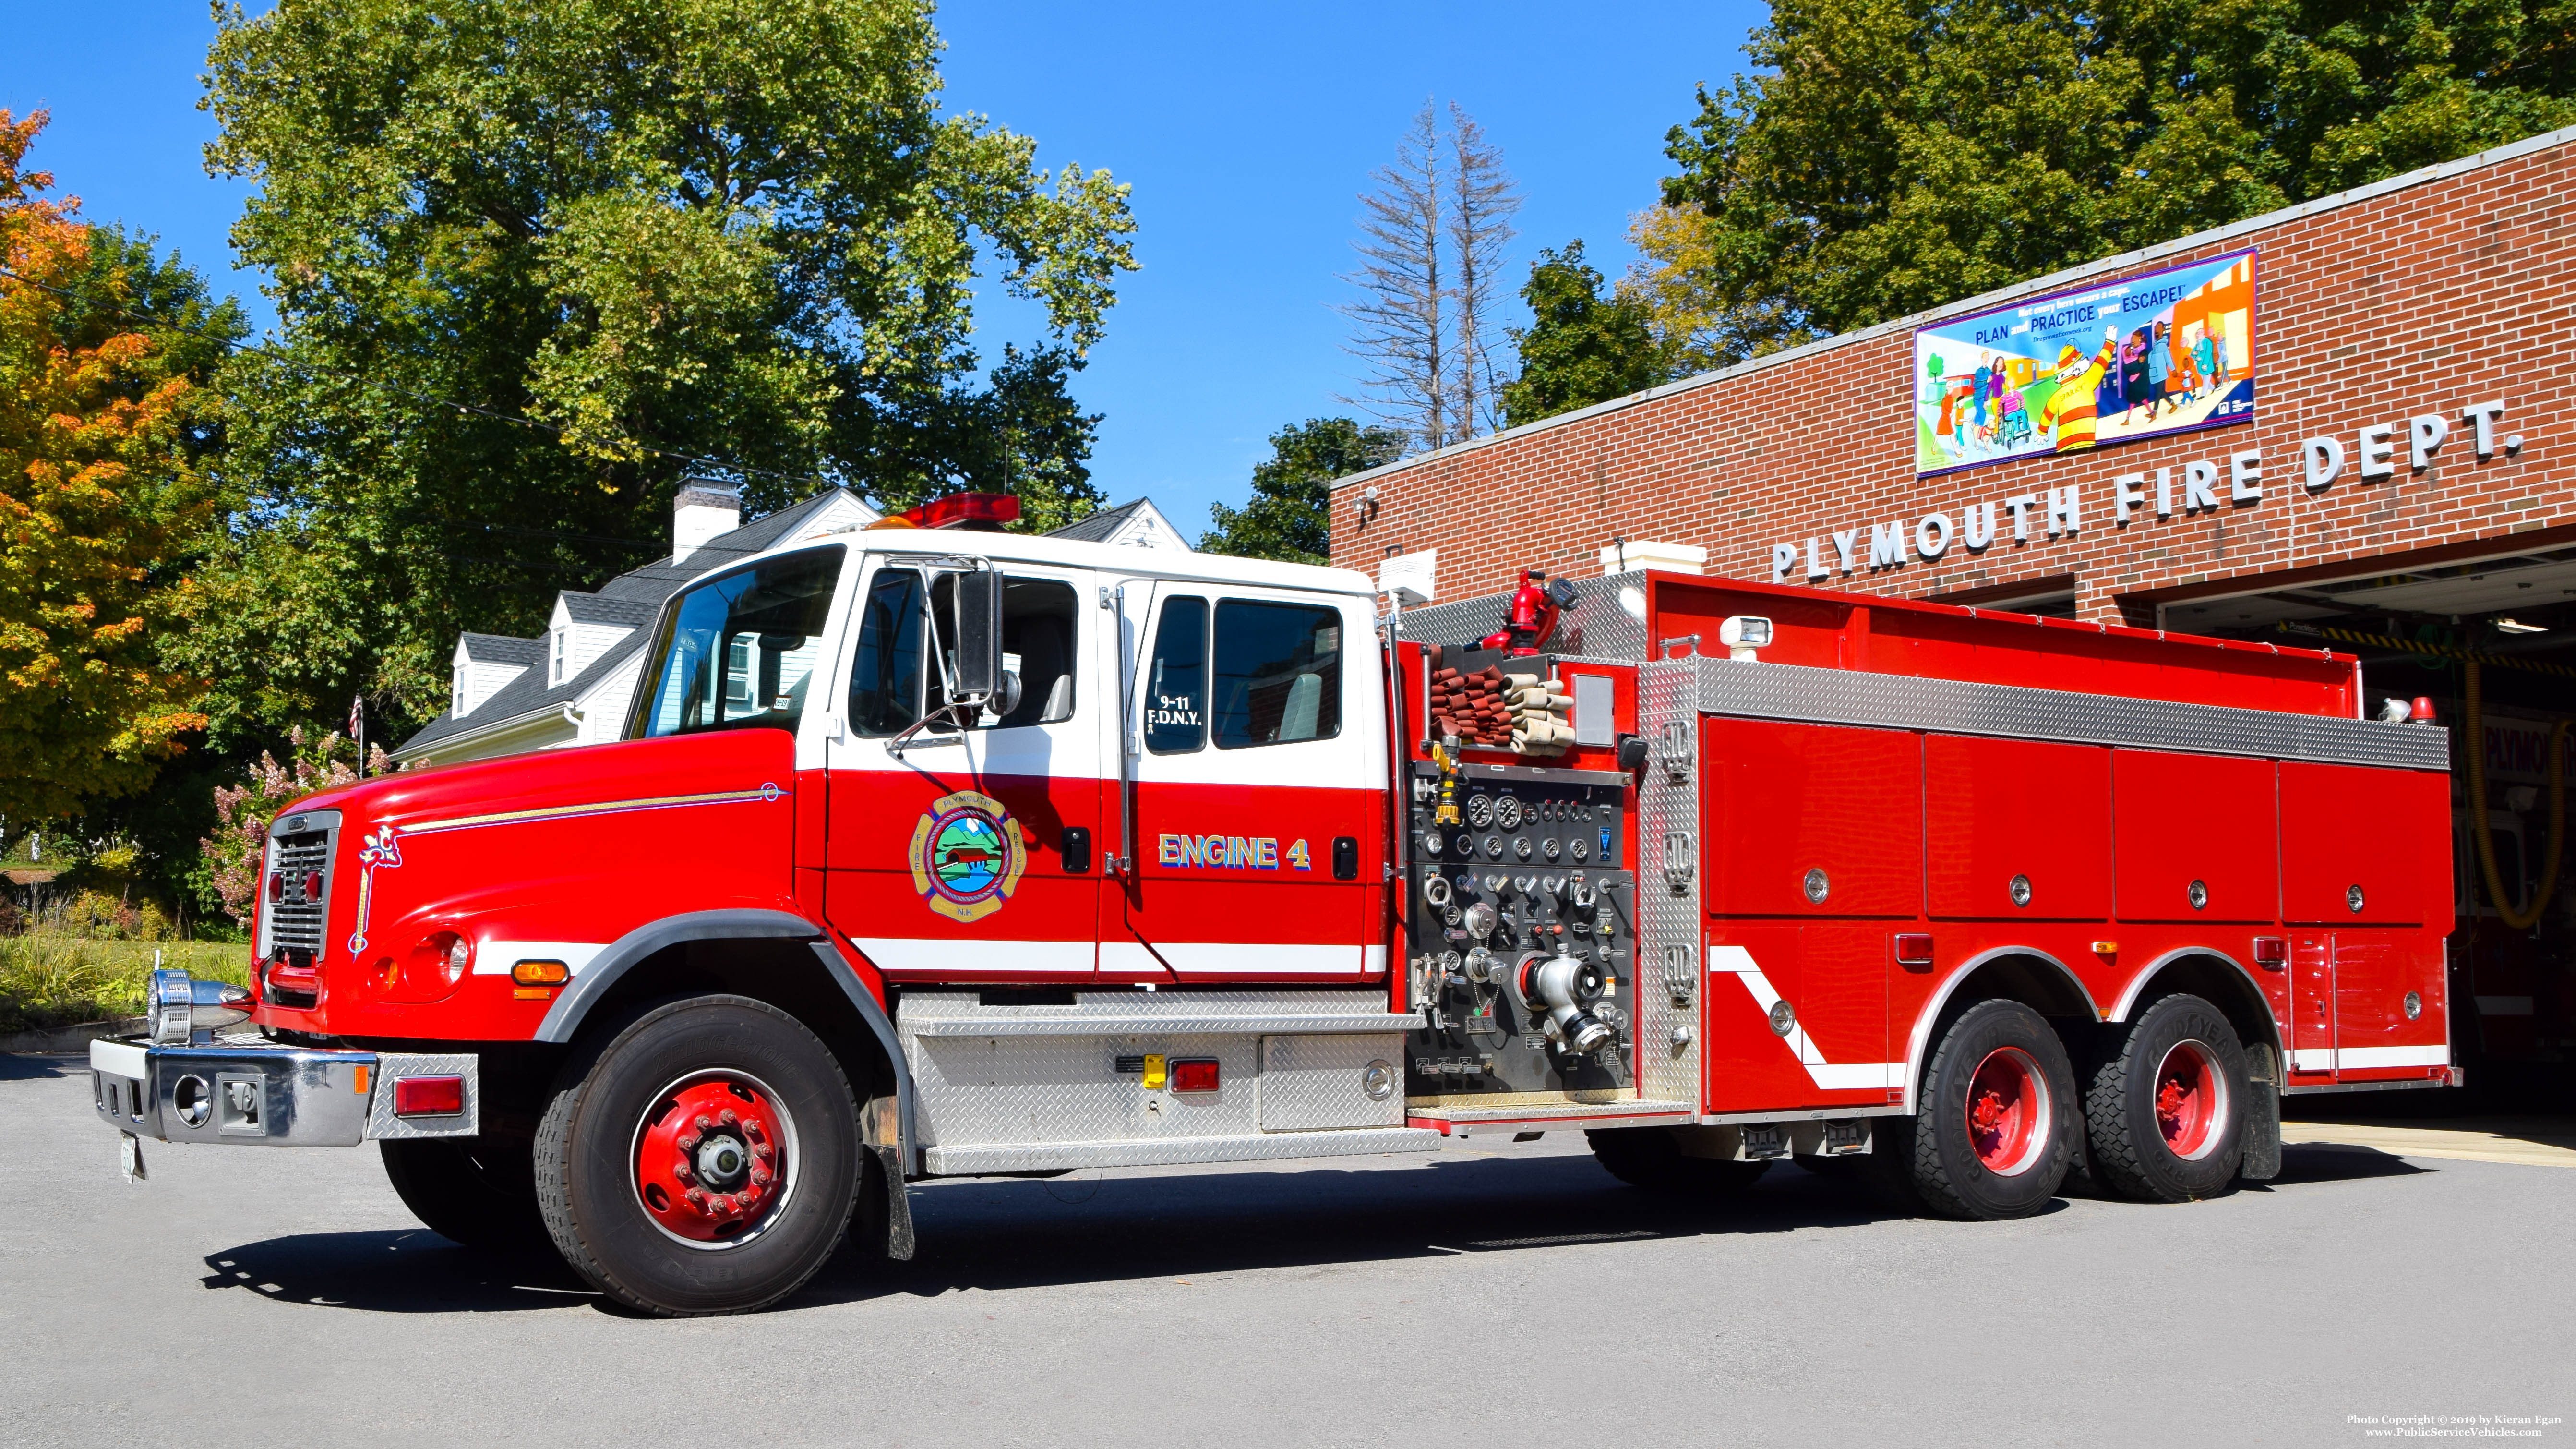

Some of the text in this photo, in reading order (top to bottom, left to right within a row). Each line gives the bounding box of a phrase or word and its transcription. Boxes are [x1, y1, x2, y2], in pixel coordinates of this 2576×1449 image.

[2018, 308, 2033, 317] Not
[2034, 303, 2055, 314] every
[2075, 293, 2100, 304] wears
[2108, 287, 2131, 298] cape.
[1976, 325, 2008, 345] PLAN
[2011, 320, 2029, 335] and
[2031, 306, 2095, 332] PRACTICE
[2097, 303, 2121, 319] your
[2033, 326, 2092, 342] firepreventionweek.org
[1773, 399, 2524, 584] PLYMOUTH FIRE DEPT.
[1148, 710, 1202, 725] F.D.N.Y.
[1160, 696, 1189, 710] 9-11
[943, 795, 991, 808] PLYMOUTH
[1013, 833, 1022, 876] RESCUE
[1158, 834, 1311, 871] ENGINE 4
[957, 907, 973, 917] N.H.
[651, 1034, 803, 1080] BRIDGESTONE
[2147, 1013, 2240, 1070] GOODYEAR
